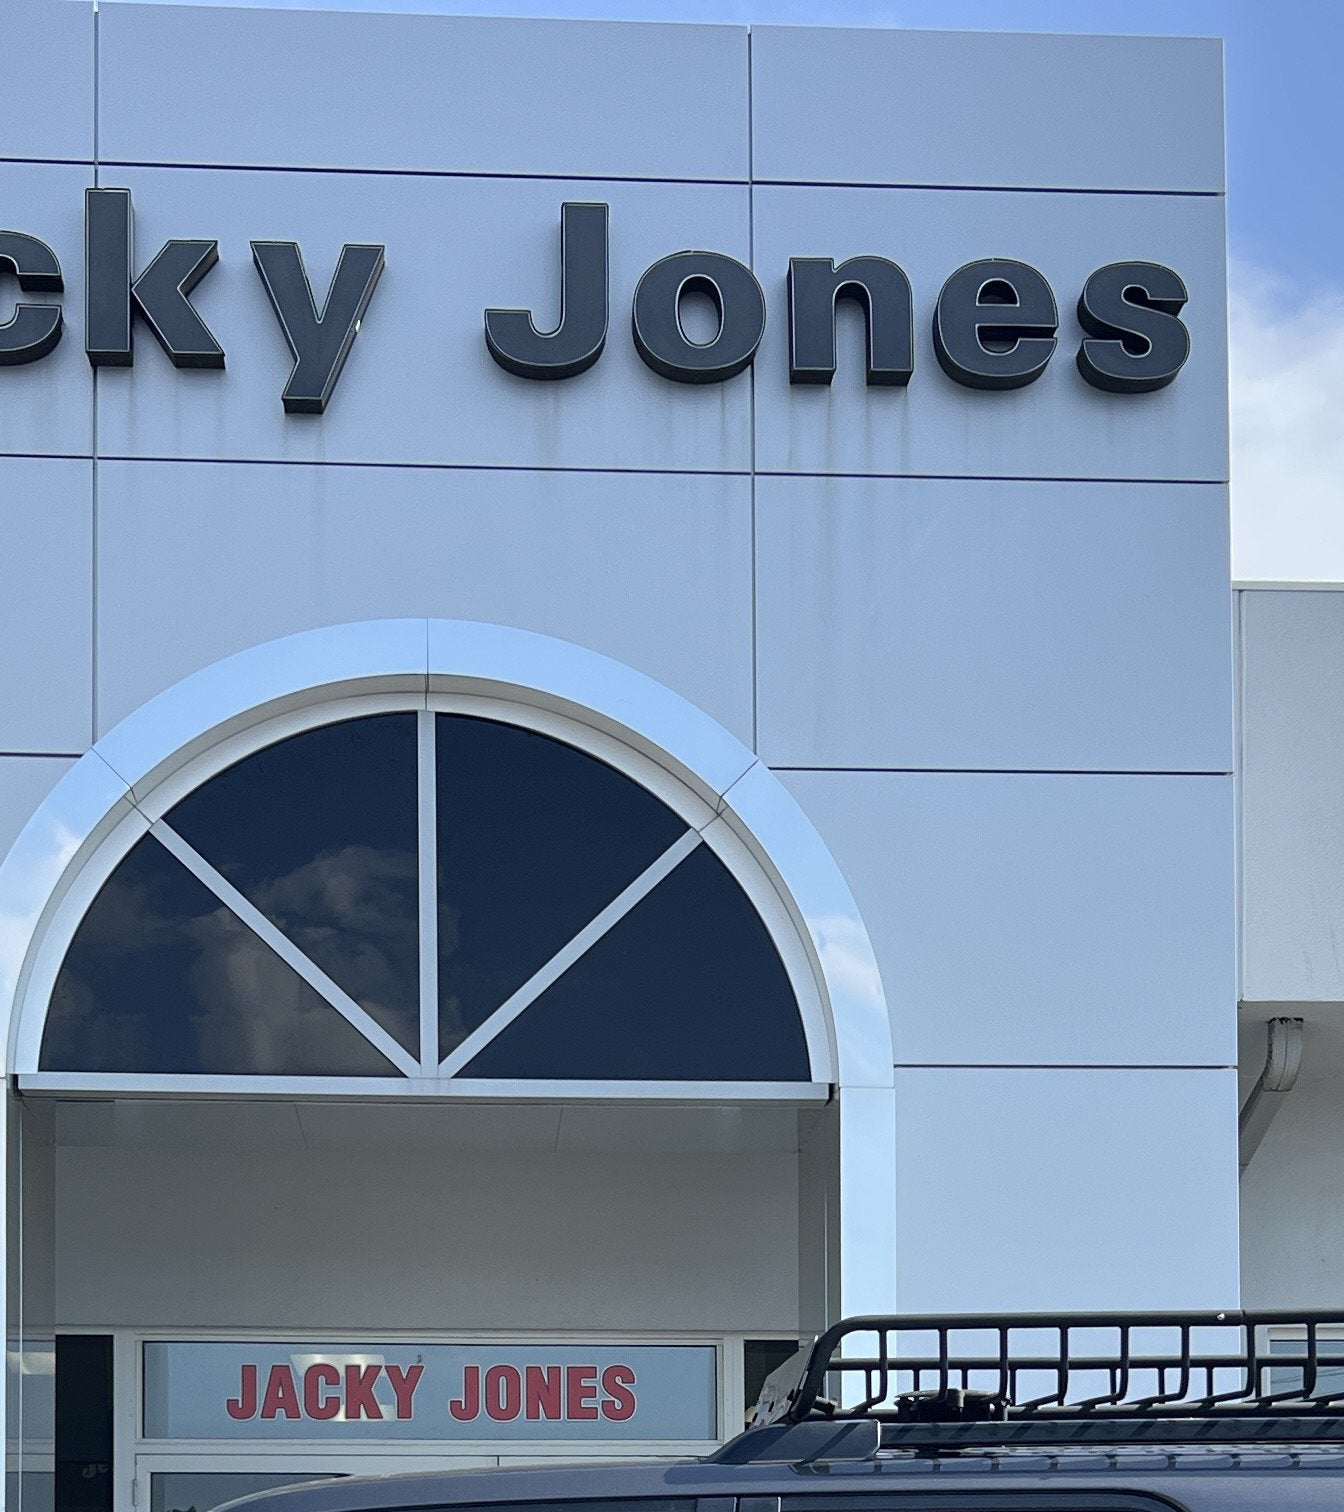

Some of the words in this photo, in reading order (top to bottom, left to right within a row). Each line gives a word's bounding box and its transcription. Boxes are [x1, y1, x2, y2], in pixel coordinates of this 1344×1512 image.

[484, 202, 1192, 394] Jones
[225, 1363, 425, 1422] JACKY
[448, 1364, 638, 1424] JONES
